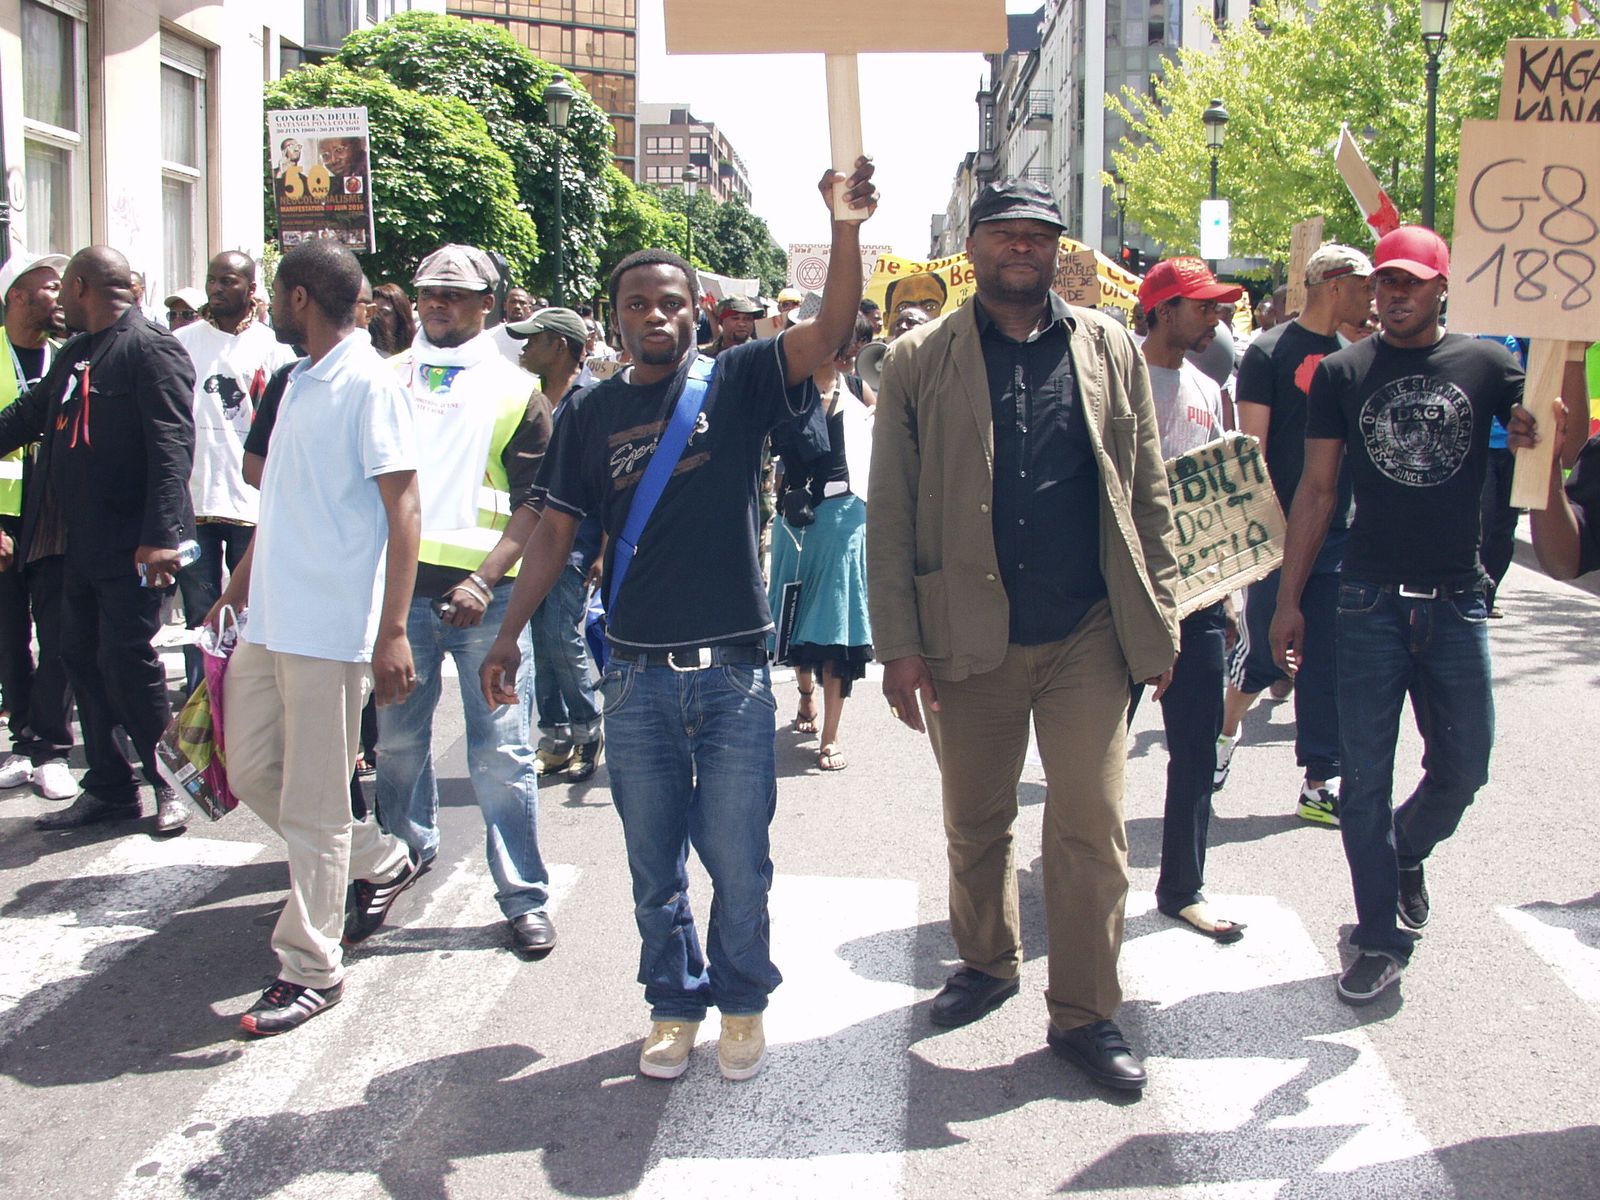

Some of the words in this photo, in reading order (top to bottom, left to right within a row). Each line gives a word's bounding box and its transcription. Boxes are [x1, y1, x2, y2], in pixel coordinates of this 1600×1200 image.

[275, 114, 309, 122] CONGO
[312, 113, 325, 121] EN
[328, 112, 360, 121] DEUIL
[285, 164, 331, 200] 50
[280, 194, 362, 205] NEOCOLOIALISME
[348, 203, 364, 211] 2010
[1470, 158, 1600, 245] G8
[1080, 277, 1093, 286] DE
[1412, 378, 1469, 417] SUMMER
[1397, 405, 1441, 421] D&G
[1394, 467, 1424, 483] SINCE
